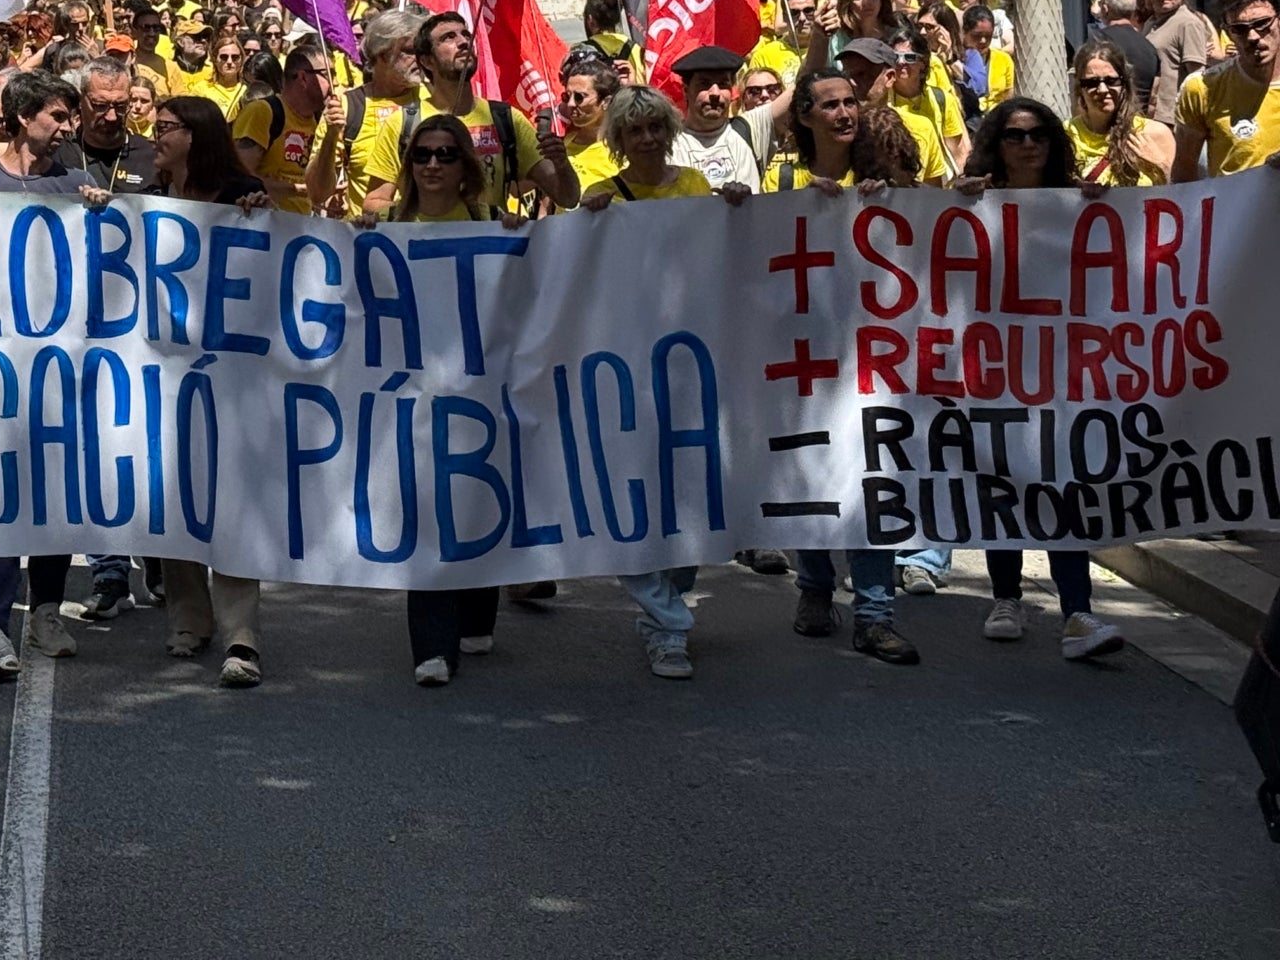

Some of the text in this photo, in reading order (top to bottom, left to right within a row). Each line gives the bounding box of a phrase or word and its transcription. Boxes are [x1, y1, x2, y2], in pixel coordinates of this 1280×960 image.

[285, 151, 302, 162] CGT
[852, 196, 1216, 320] SALARI
[856, 310, 1230, 404] RECURSOS
[284, 330, 726, 563] PÚBLICA
[861, 397, 1169, 484] RÀTIOS
